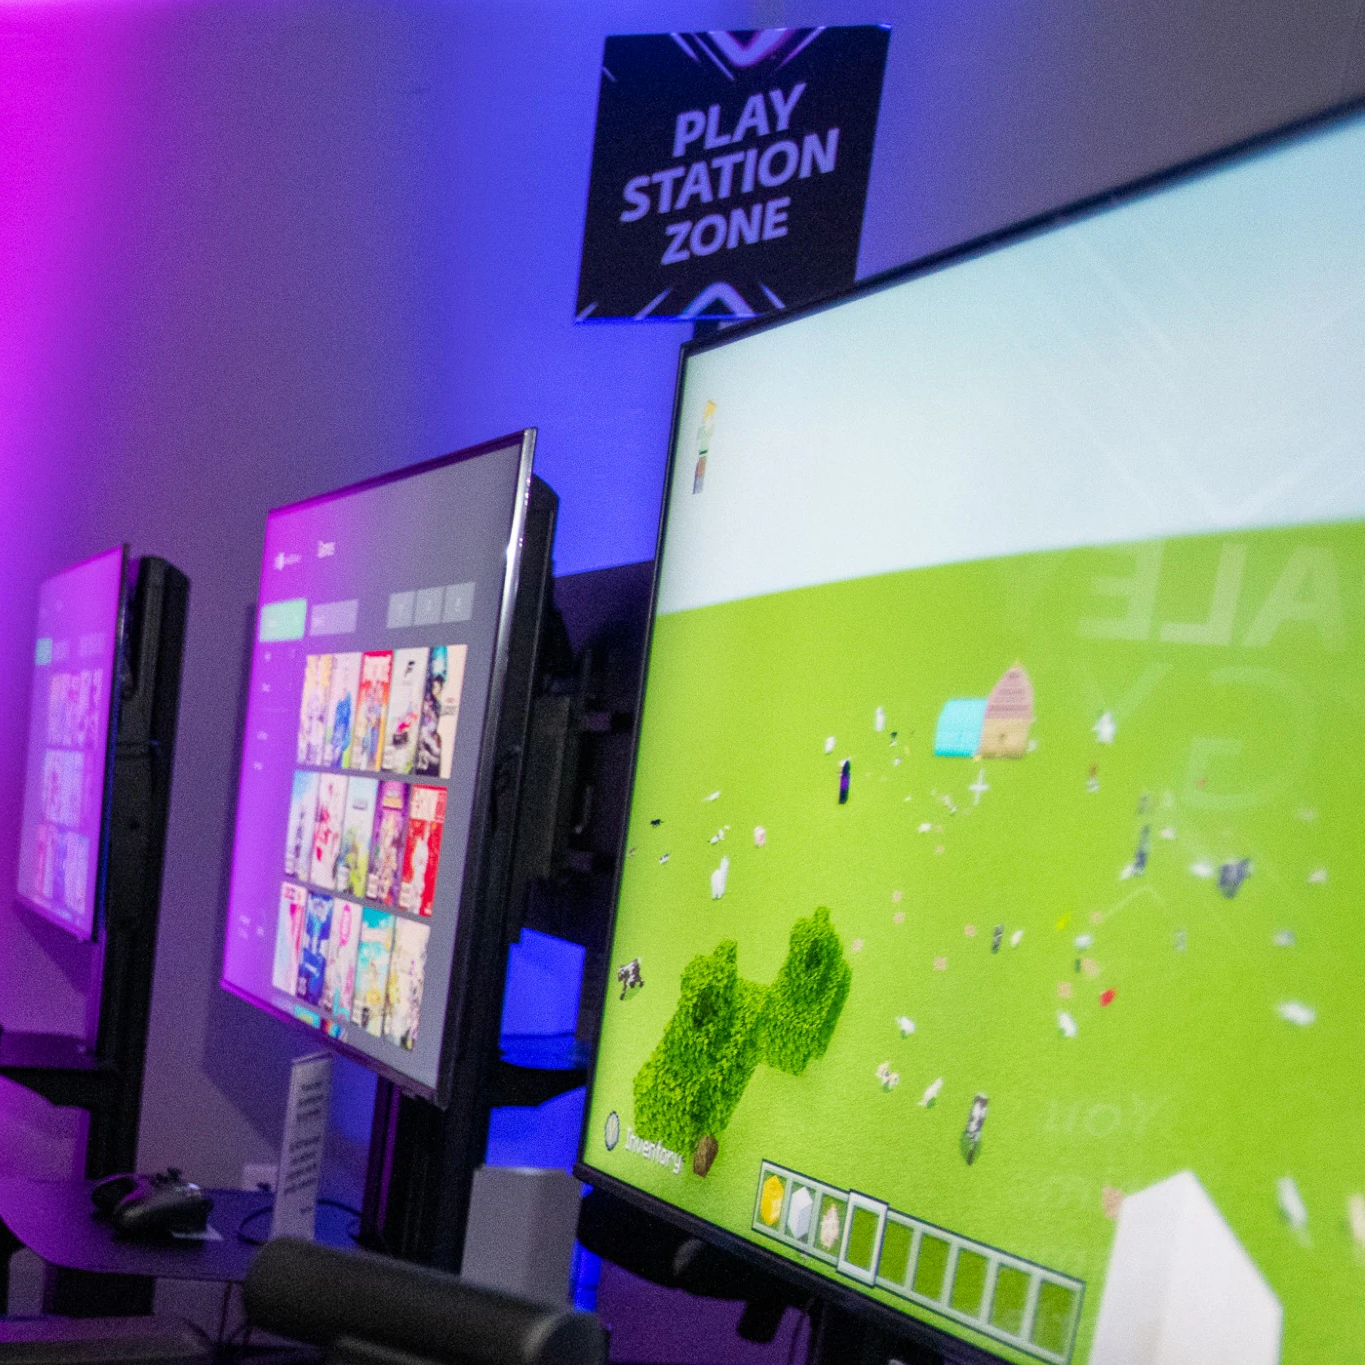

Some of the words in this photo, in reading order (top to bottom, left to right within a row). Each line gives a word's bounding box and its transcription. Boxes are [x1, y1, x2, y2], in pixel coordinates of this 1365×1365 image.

[672, 83, 807, 158] PLAY
[620, 128, 840, 222] STATION
[660, 197, 791, 266] ZONE
[625, 1126, 684, 1175] Inventory
